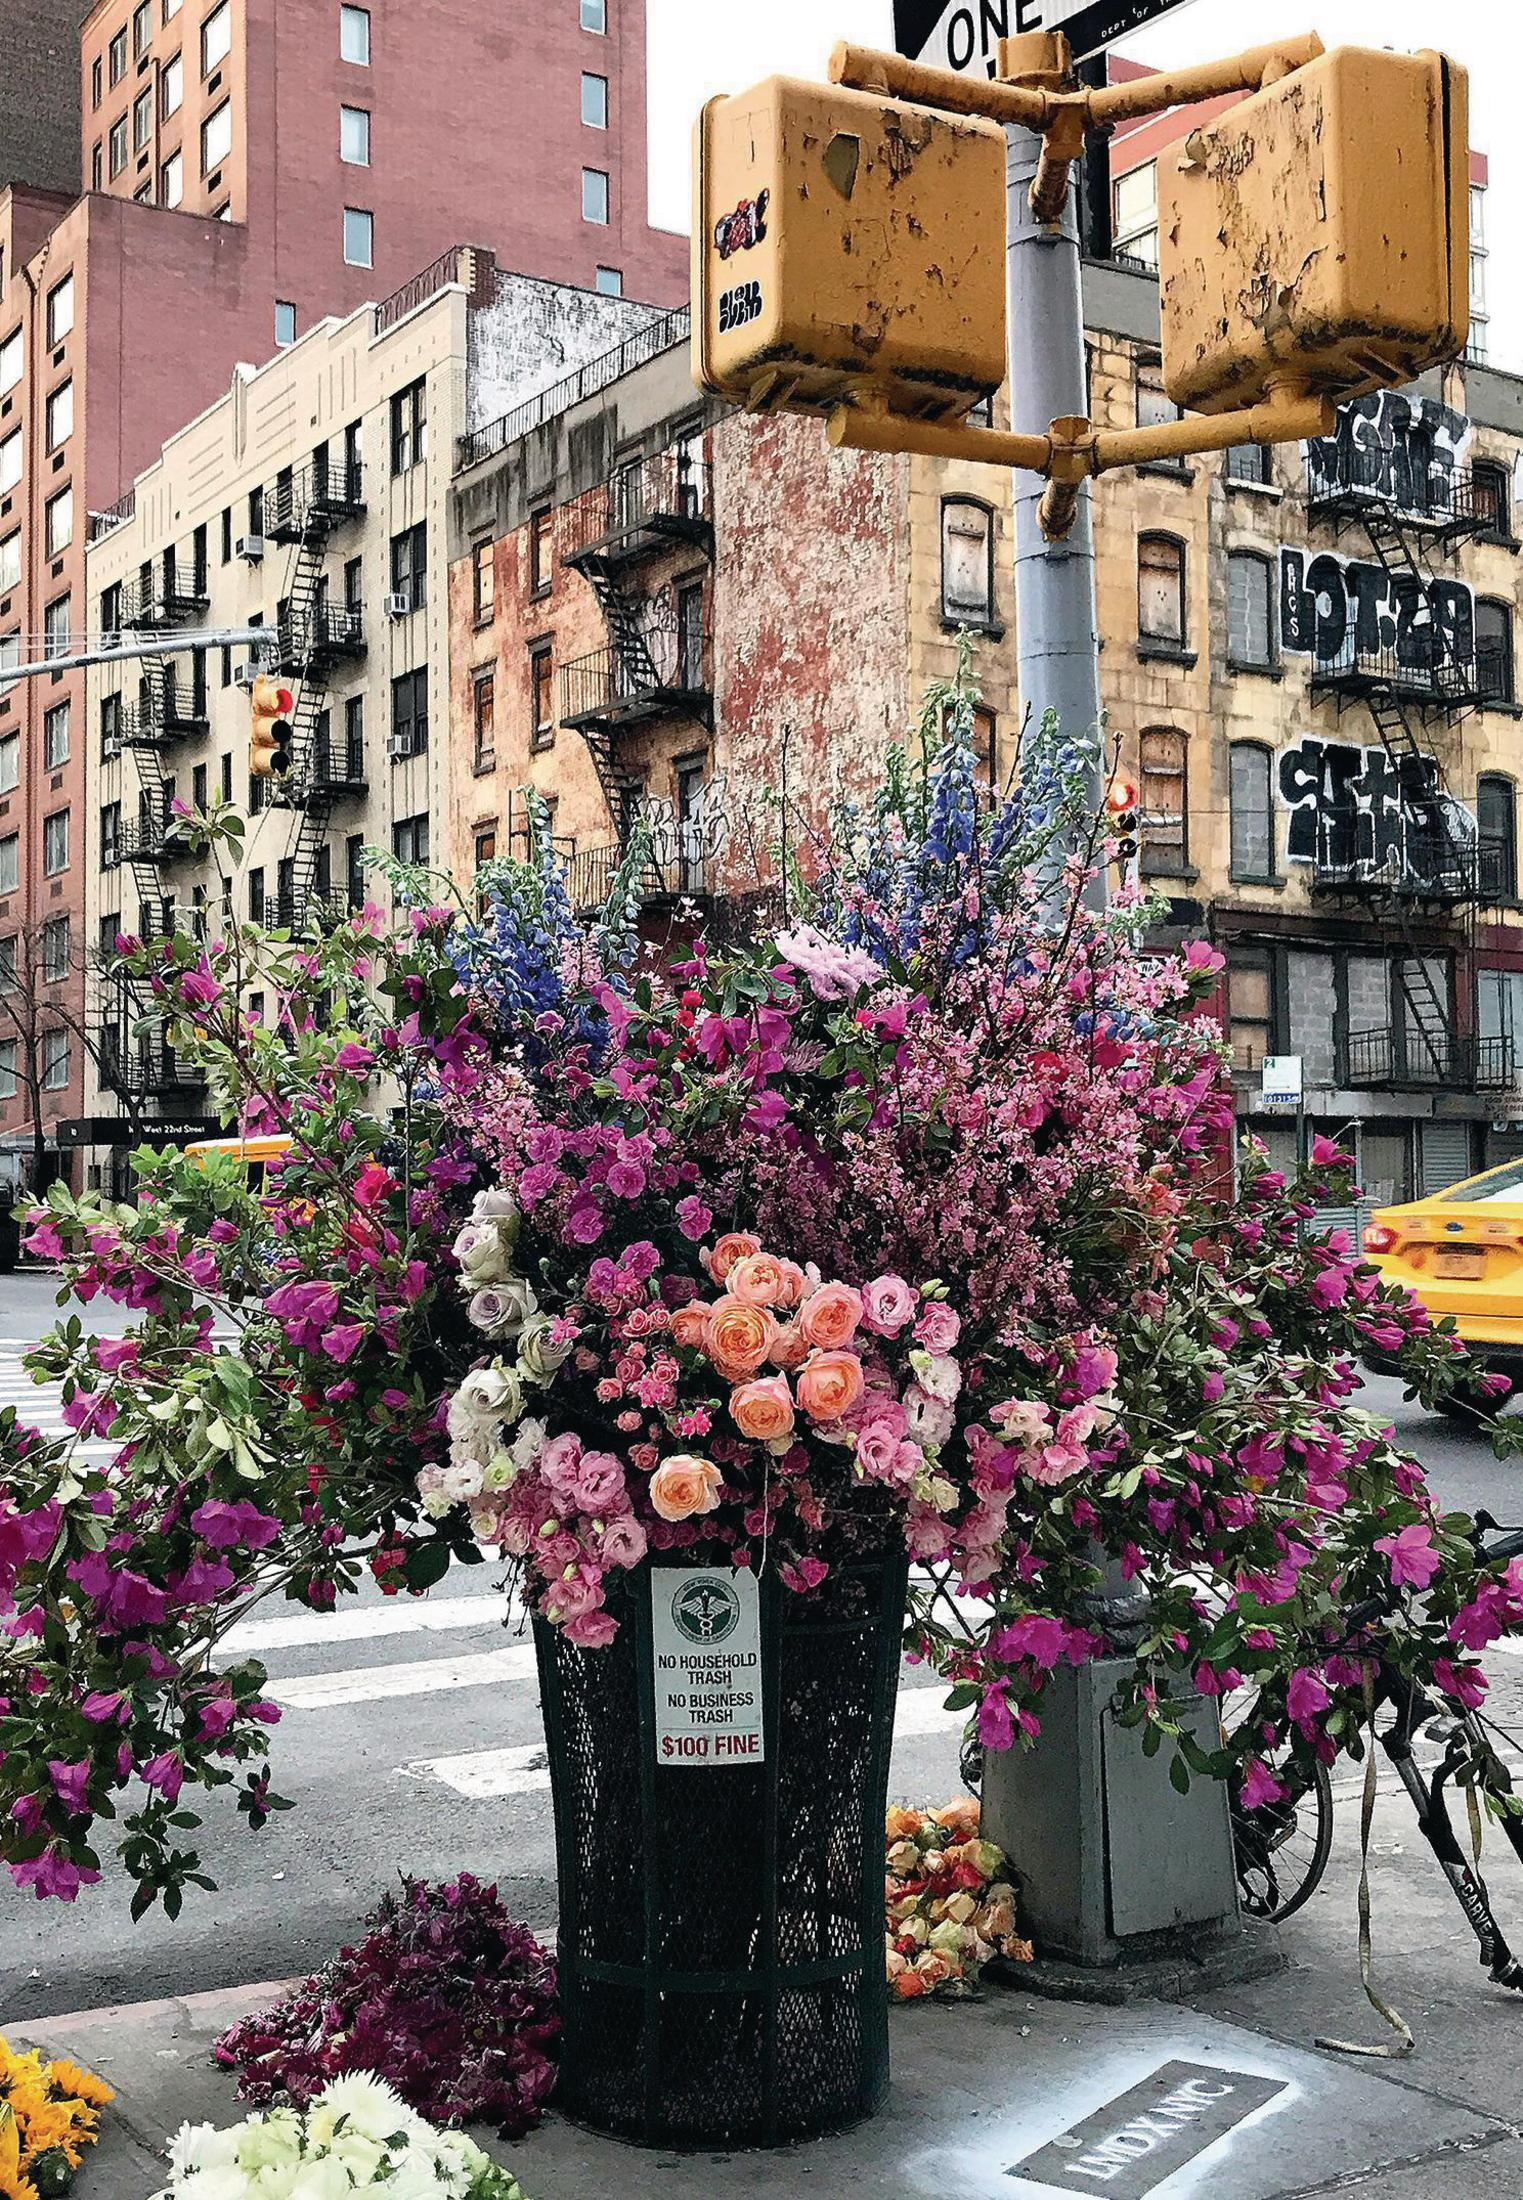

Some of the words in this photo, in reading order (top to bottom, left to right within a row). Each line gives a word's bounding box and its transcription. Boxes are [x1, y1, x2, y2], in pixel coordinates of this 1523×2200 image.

[947, 0, 1043, 71] ONE
[658, 1655, 676, 1669] NO
[680, 1653, 757, 1669] HOUSEHOLD
[688, 1670, 732, 1685] TRASH
[667, 1694, 687, 1708] NO
[689, 1692, 754, 1708] BUSINESS
[689, 1709, 733, 1724] TRASH
[661, 1734, 709, 1758] $100
[714, 1734, 760, 1756] FINE
[1461, 1883, 1493, 1933] CARVE
